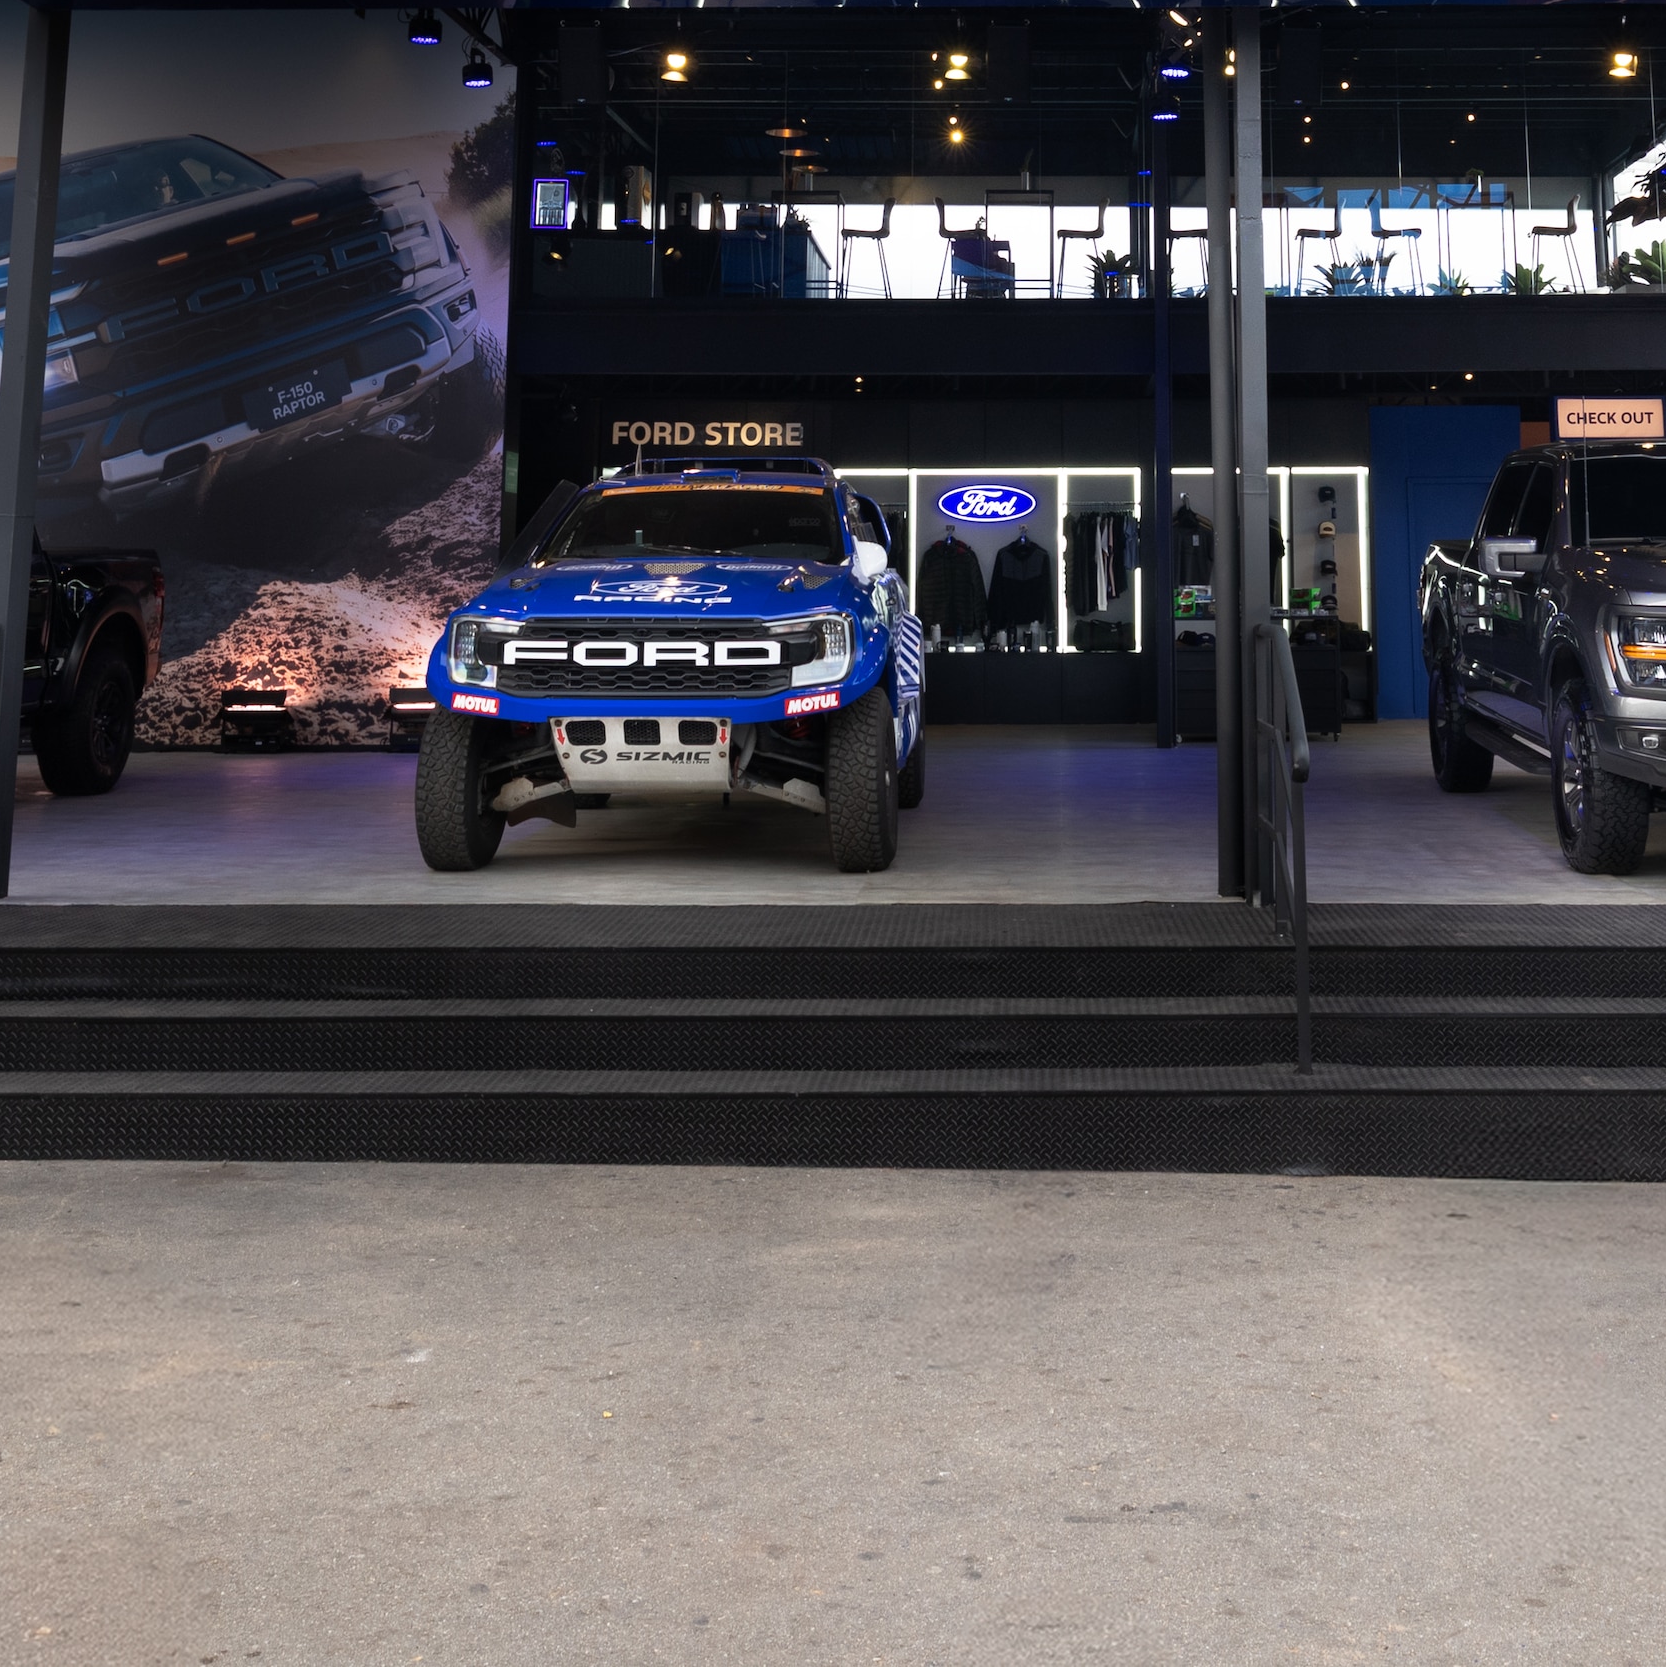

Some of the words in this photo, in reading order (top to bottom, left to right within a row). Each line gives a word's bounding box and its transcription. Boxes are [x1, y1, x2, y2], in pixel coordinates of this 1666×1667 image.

[98, 232, 394, 343] FORD
[277, 381, 313, 404] F-150
[272, 391, 326, 420] RAPTOR
[1566, 411, 1617, 425] CHECK
[1621, 411, 1654, 424] OUT
[612, 421, 696, 446] FORD
[704, 422, 802, 446] STORE
[956, 489, 1018, 516] Ford
[503, 640, 781, 666] FORD
[452, 694, 497, 713] MOTUL
[787, 693, 839, 714] MOTUL
[616, 751, 711, 761] SIZMIC
